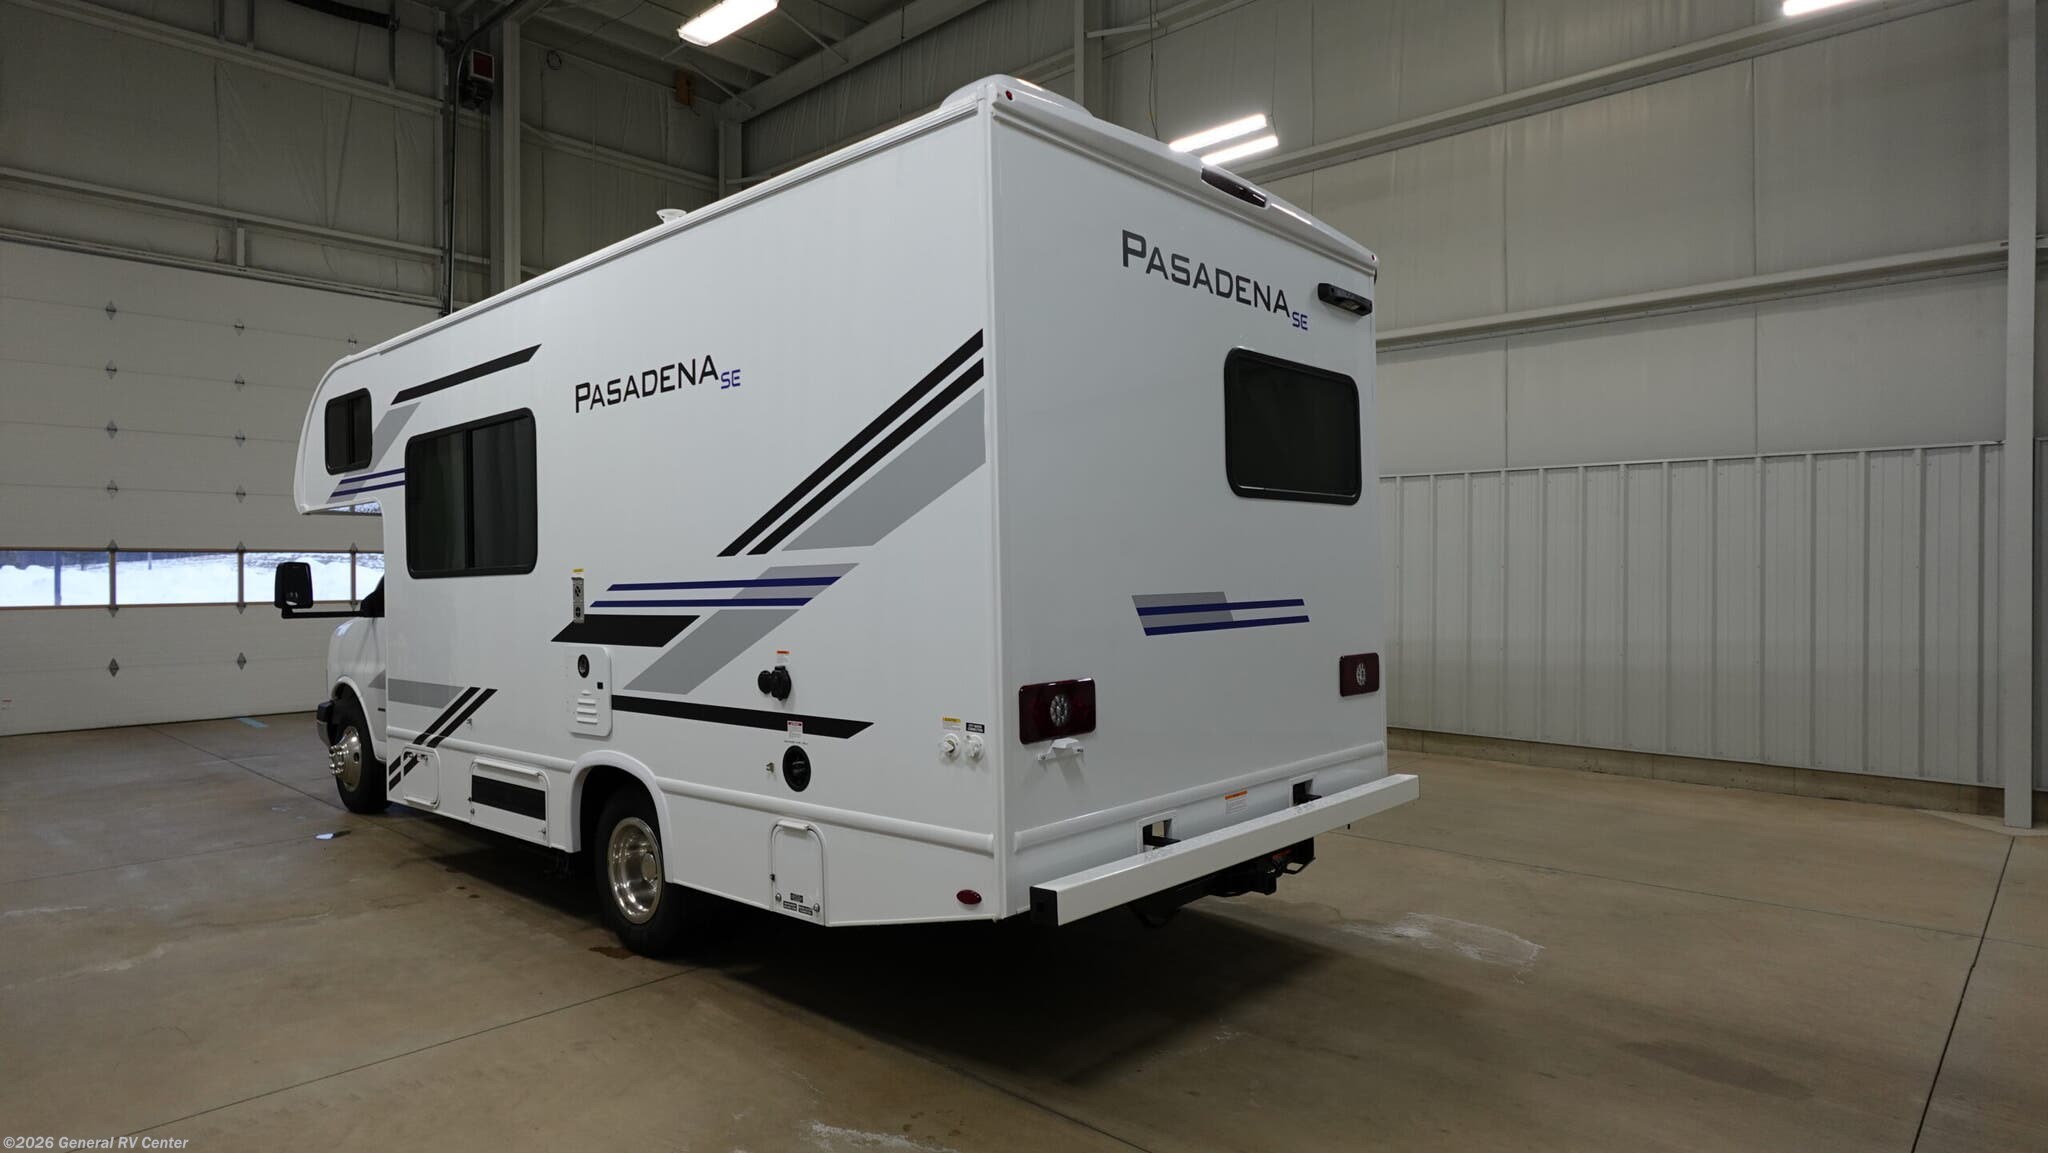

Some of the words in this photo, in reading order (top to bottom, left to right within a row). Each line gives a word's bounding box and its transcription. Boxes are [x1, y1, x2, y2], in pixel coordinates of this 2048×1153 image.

[1122, 229, 1290, 318] PASADENA
[1292, 311, 1309, 331] SE
[575, 354, 719, 414] PASADENA
[720, 369, 741, 390] SE
